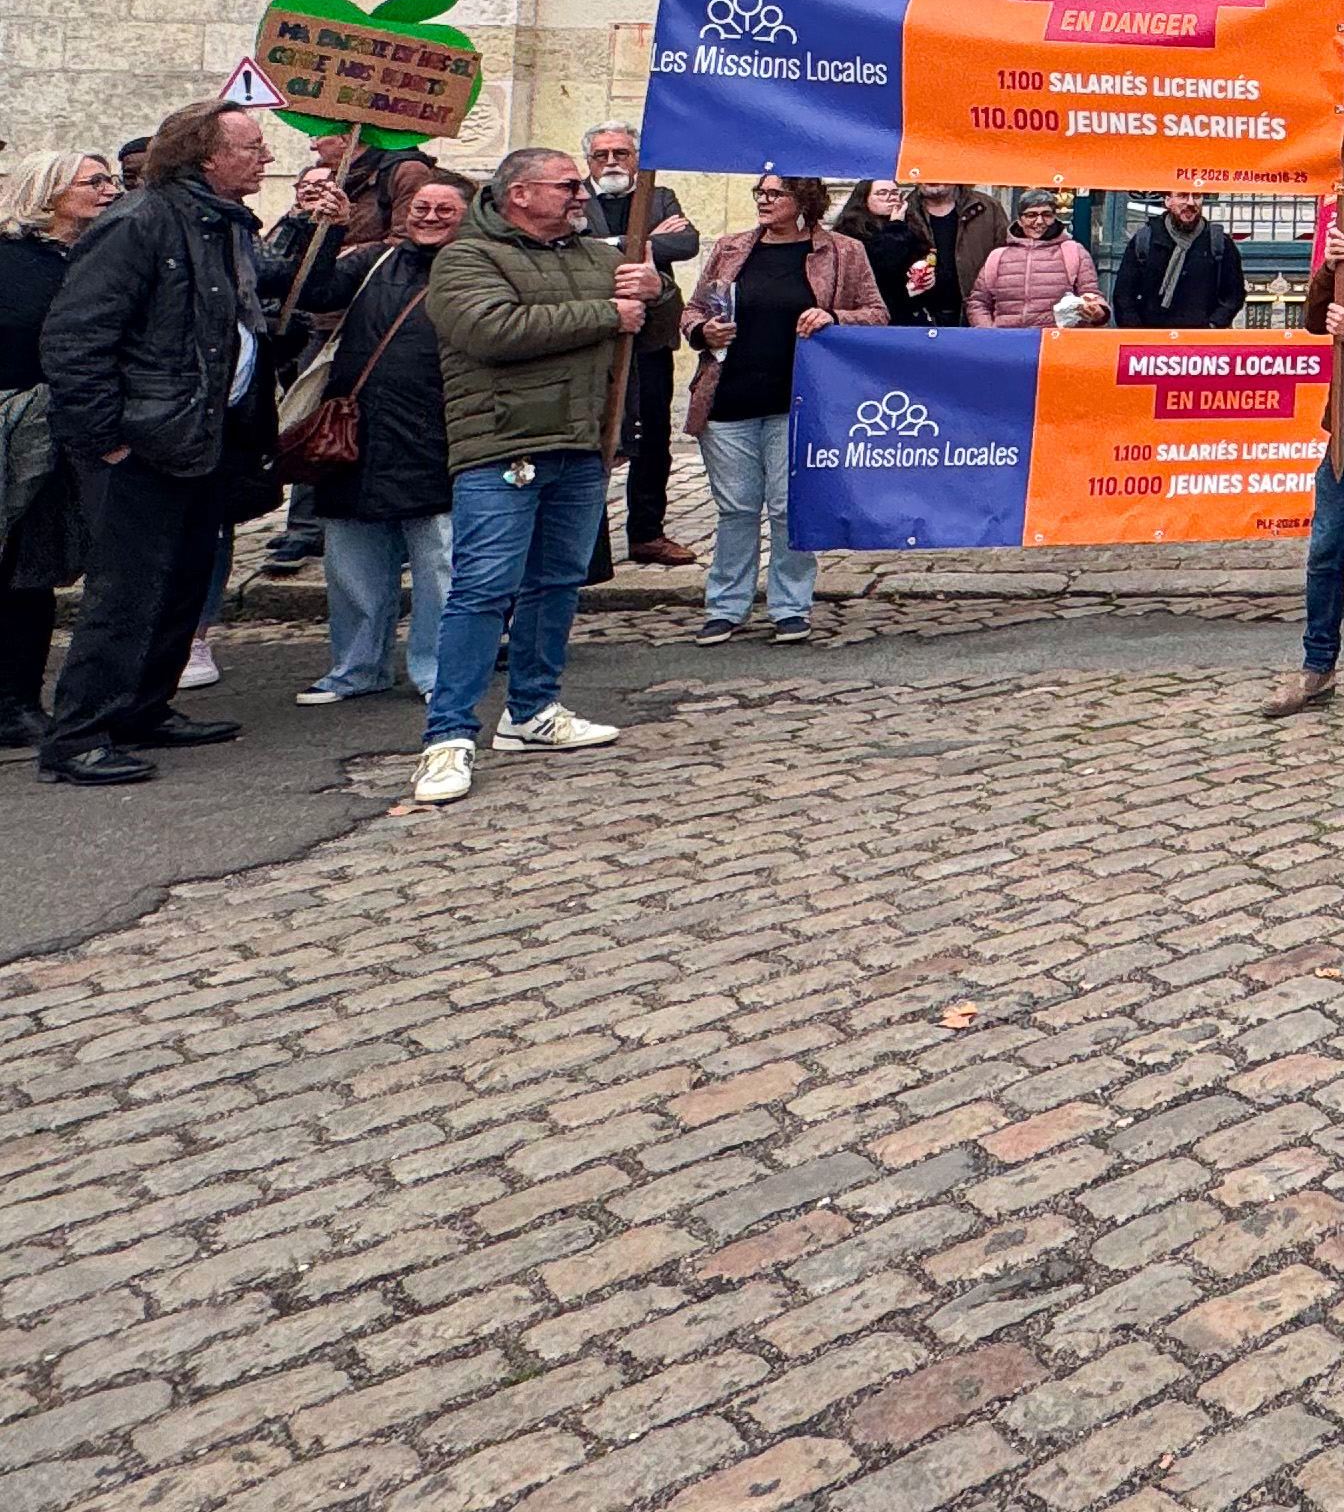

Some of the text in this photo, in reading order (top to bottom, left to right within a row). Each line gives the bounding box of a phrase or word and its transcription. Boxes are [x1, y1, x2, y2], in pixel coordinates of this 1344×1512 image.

[1060, 10, 1198, 36] EN DANGER
[650, 43, 887, 85] Les Missions Locales
[1049, 71, 1147, 96] SALARIÉS
[1153, 74, 1260, 101] LICENCIÉS
[971, 106, 1287, 140] 110.000 JEUNES SACRIFIÉS
[1128, 356, 1320, 376] MISSIONS LOCALES
[1166, 390, 1280, 410] EN DANGER
[807, 441, 1019, 468] Les Missions Locales
[1157, 440, 1238, 462] SALARIÉS
[1242, 439, 1327, 460] LICENCIÉS
[1088, 473, 1316, 498] 110.000 JEUNES SACRIF
